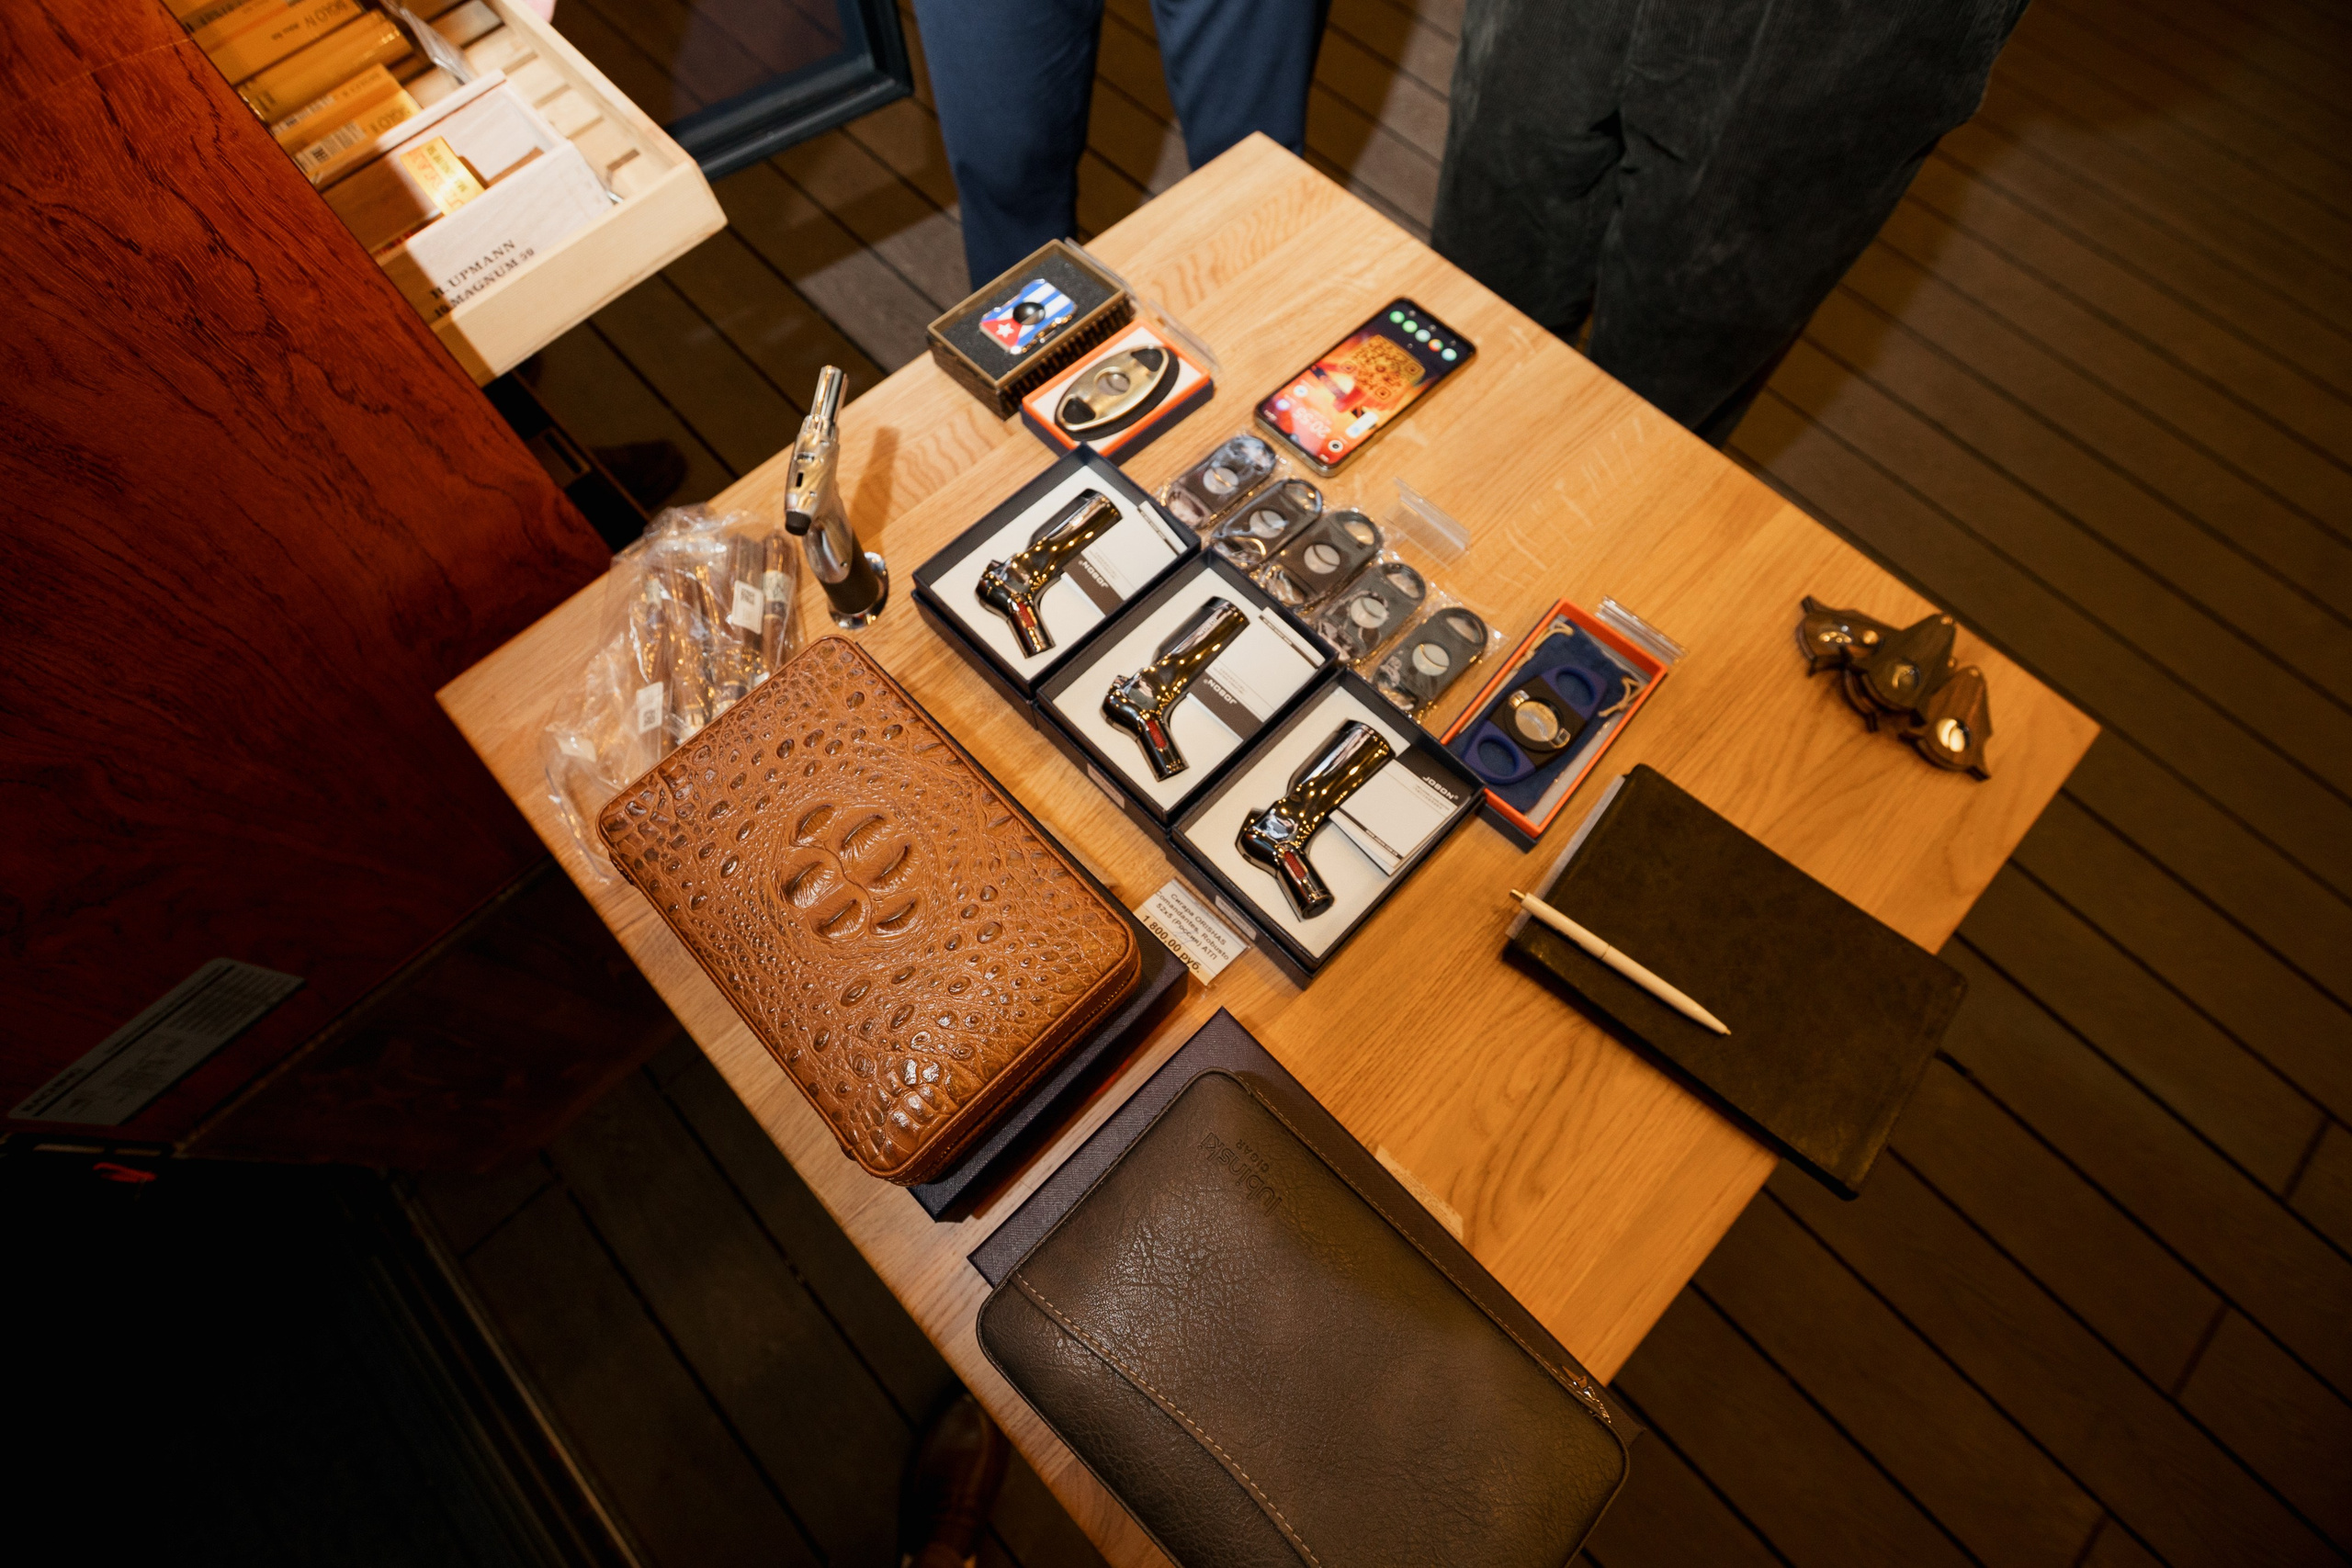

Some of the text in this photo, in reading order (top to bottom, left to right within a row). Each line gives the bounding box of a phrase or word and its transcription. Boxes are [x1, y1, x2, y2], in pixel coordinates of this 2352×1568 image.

[429, 240, 516, 299] H. UPMANN
[449, 259, 519, 307] MAGNUM
[519, 247, 535, 261] 50
[1170, 894, 1193, 917] Сигара
[1194, 916, 1227, 946] ORISHAS
[1171, 919, 1202, 947] (Россия)
[1179, 952, 1203, 974] руб.
[1201, 932, 1229, 961] Robusto
[1197, 1132, 1283, 1218] lubinski
[1235, 1138, 1270, 1173] CIGAR
